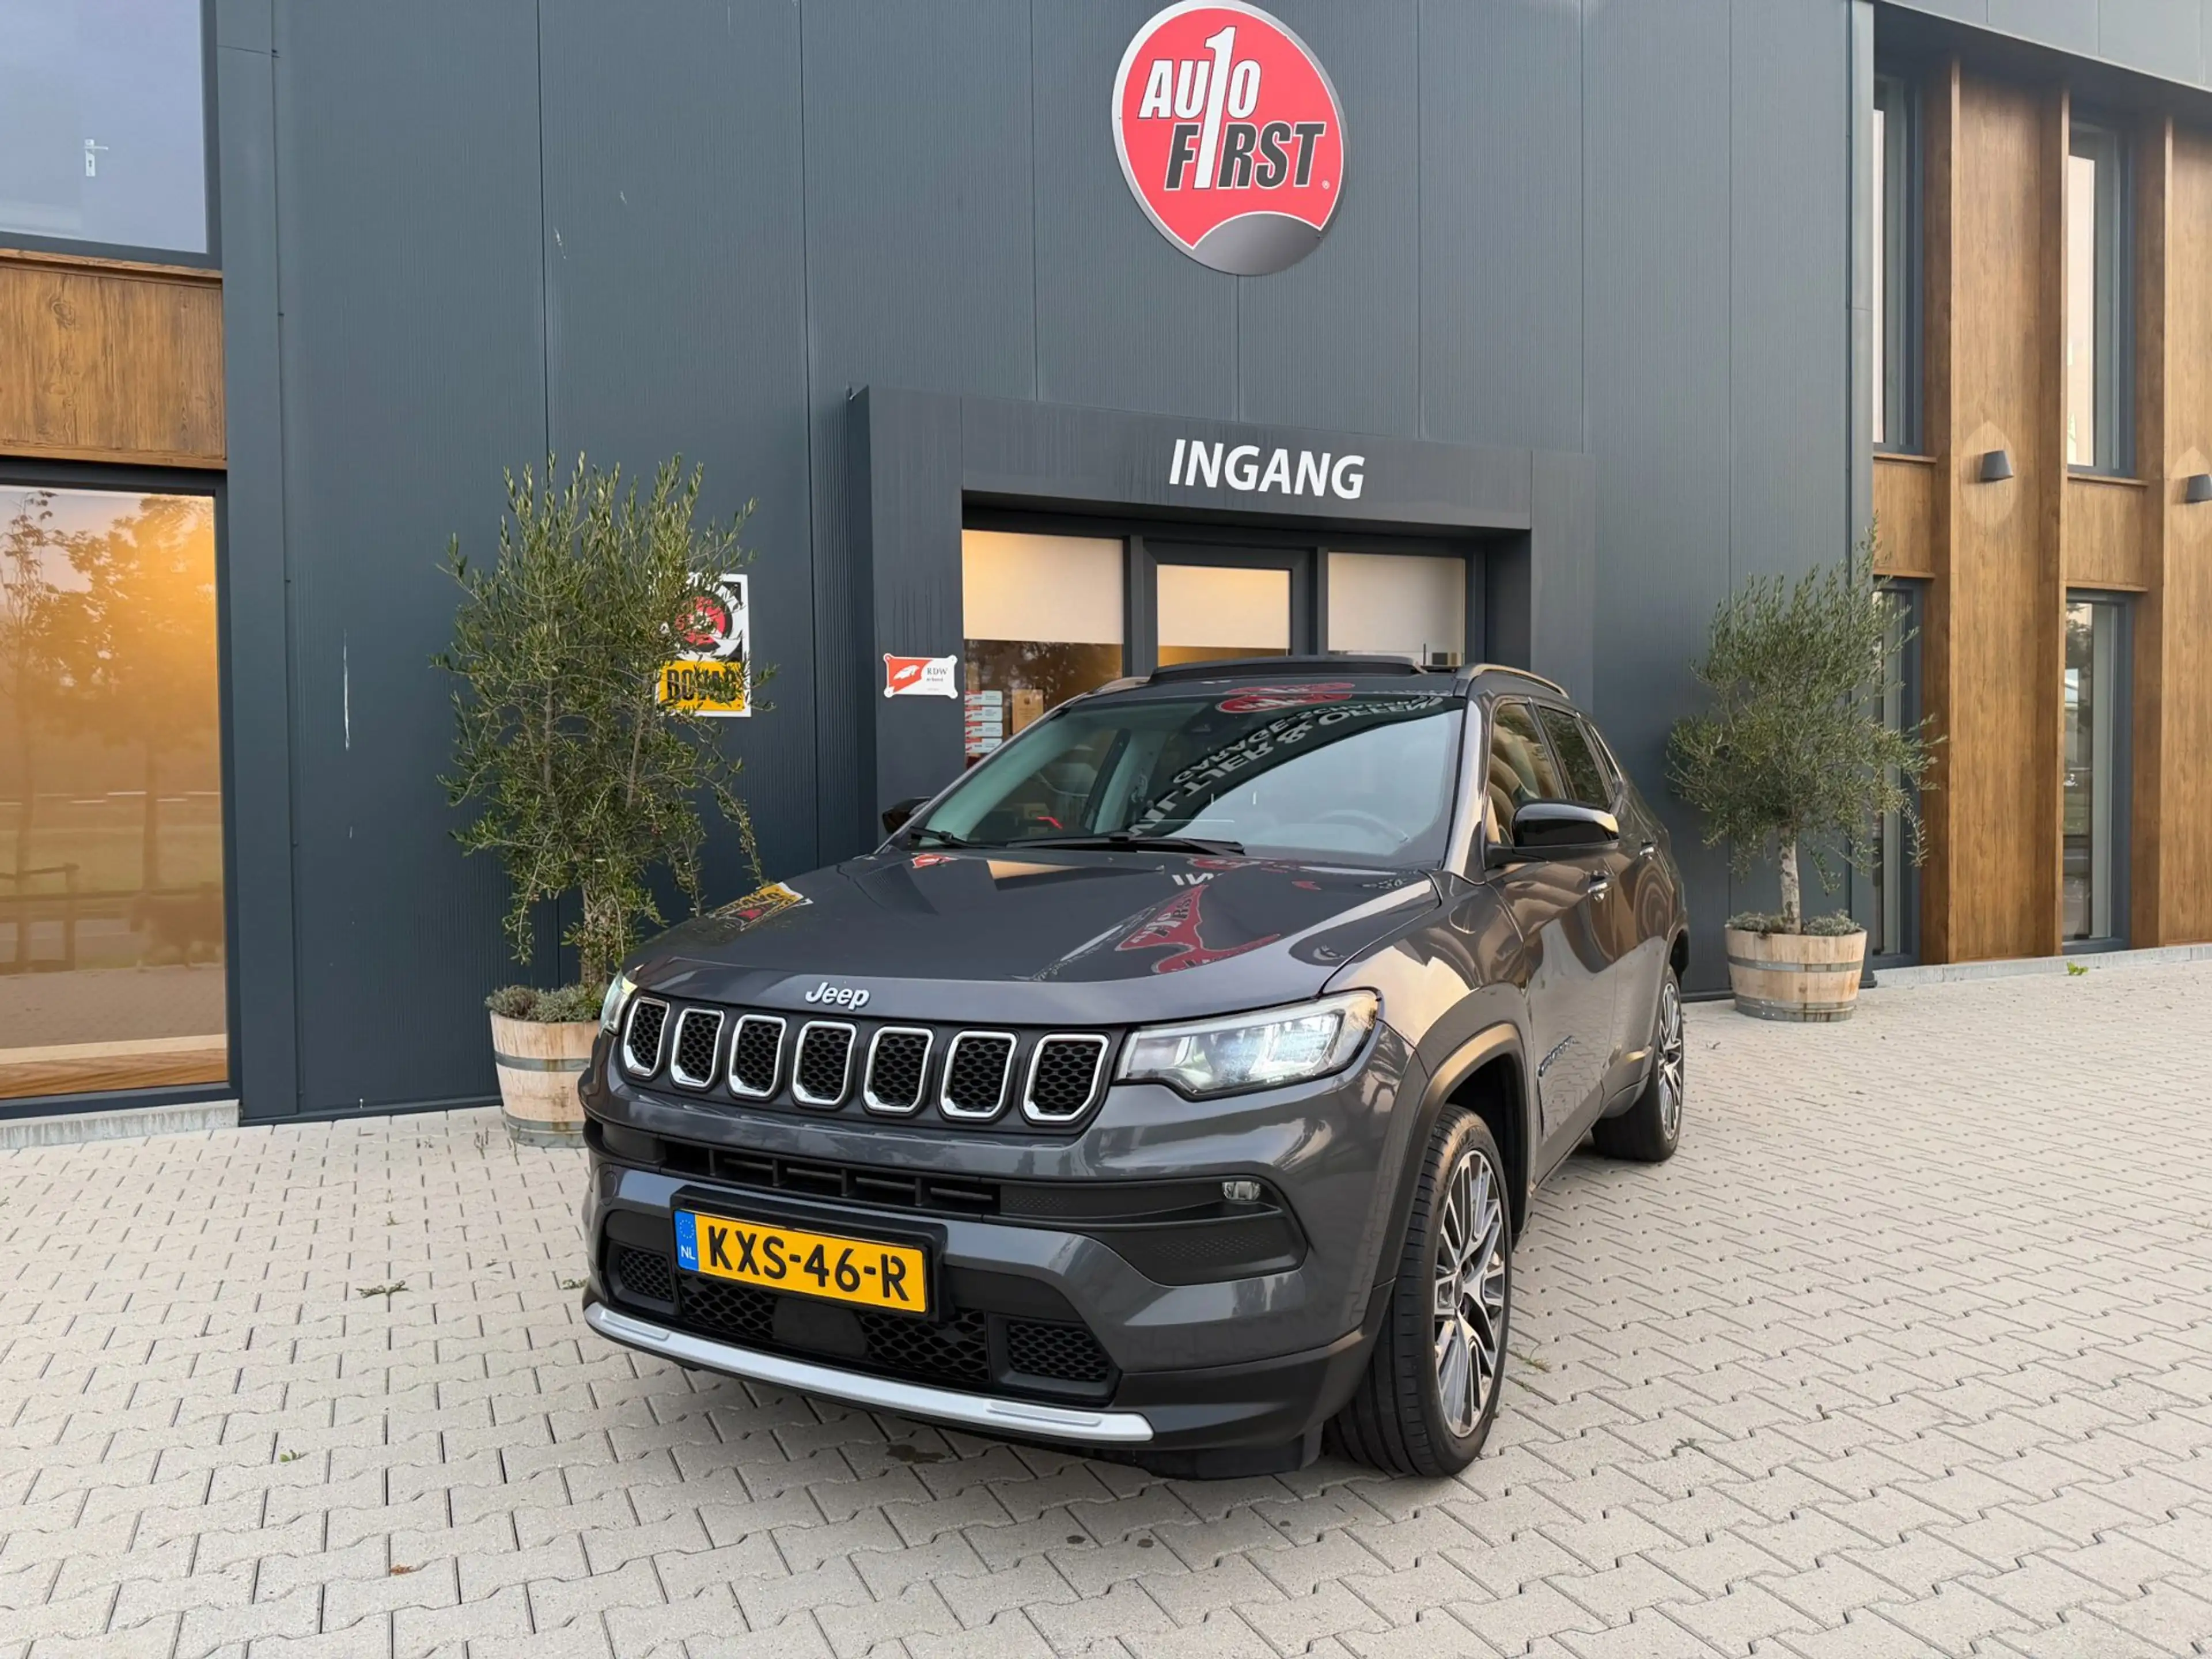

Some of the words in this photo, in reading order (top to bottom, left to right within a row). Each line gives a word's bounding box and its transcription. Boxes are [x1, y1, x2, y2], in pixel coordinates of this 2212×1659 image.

[1169, 438, 1365, 499] INGANG
[927, 667, 949, 675] RDW
[805, 982, 870, 1010] Jeep
[680, 1245, 696, 1260] NL
[708, 1225, 910, 1302] KXS-46-R
